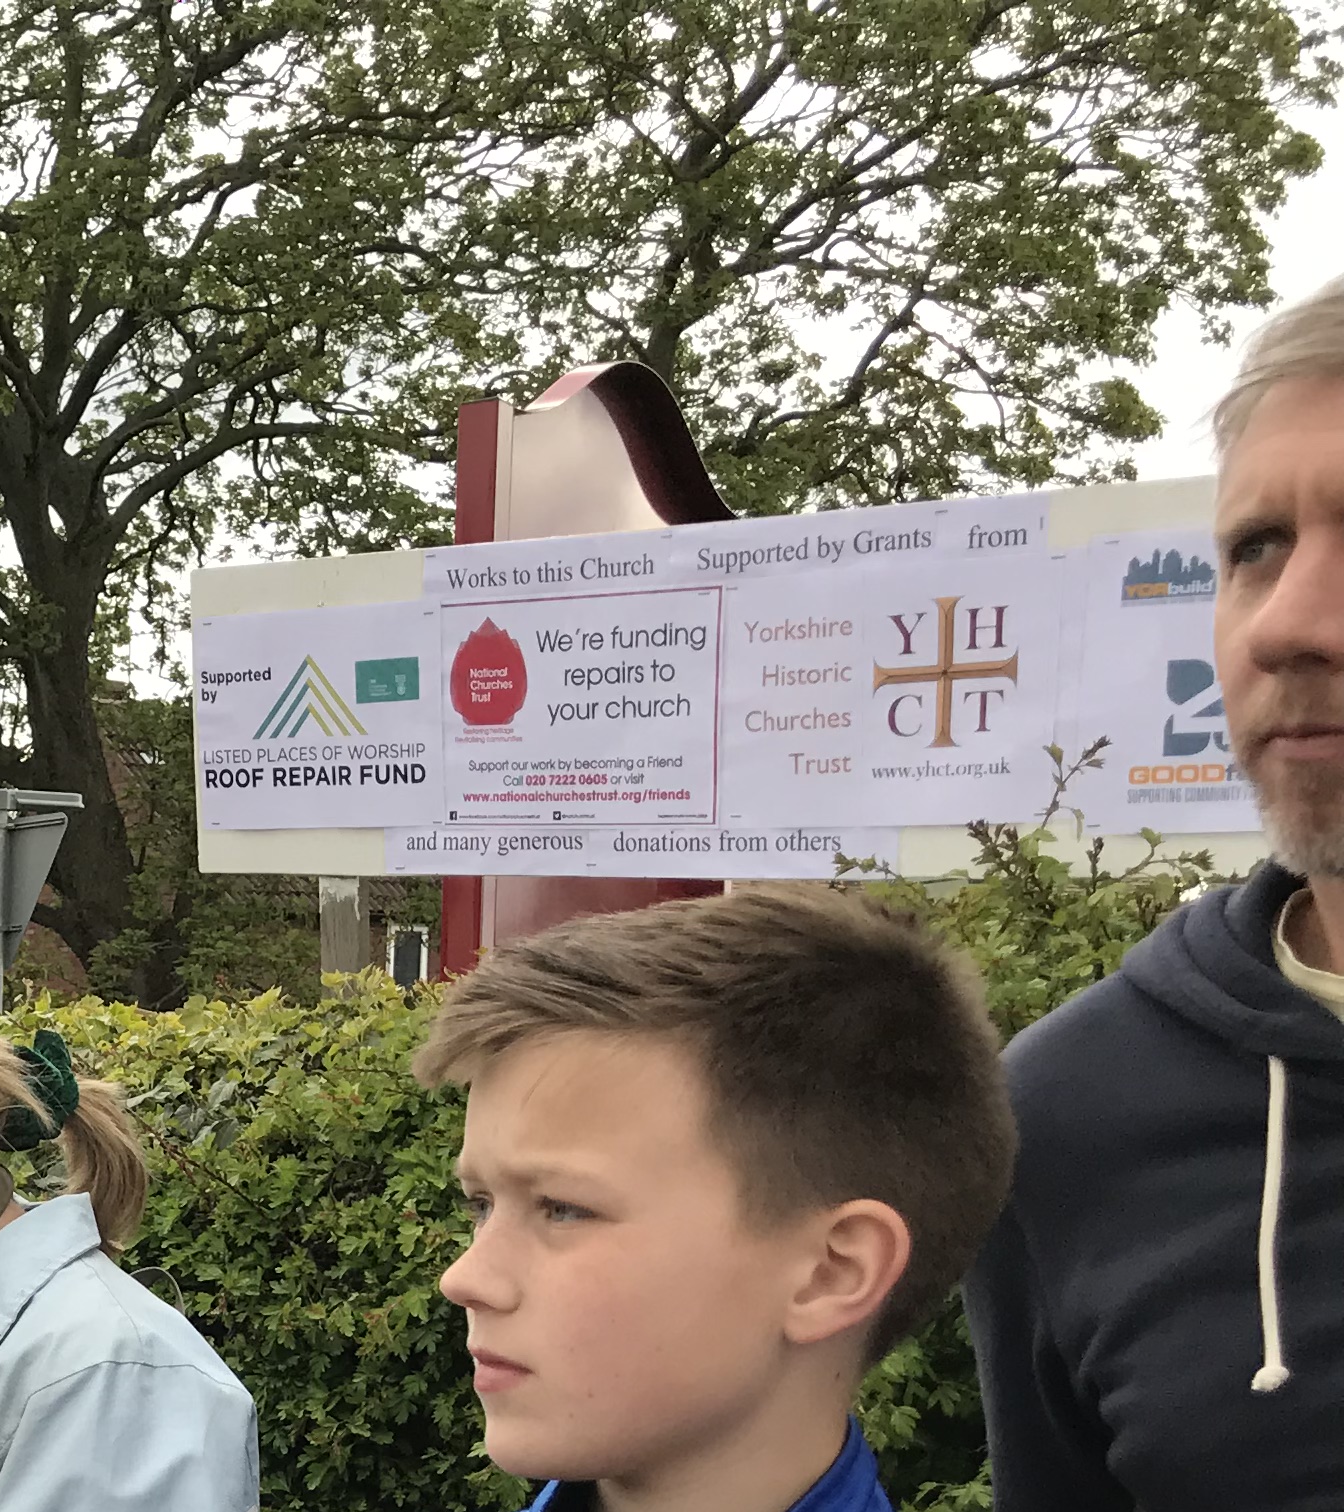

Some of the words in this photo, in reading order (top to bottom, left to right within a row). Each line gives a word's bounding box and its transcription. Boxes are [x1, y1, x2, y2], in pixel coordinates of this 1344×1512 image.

[446, 567, 507, 589] Works
[513, 568, 531, 585] to
[538, 560, 573, 583] this
[580, 553, 654, 580] Church
[697, 537, 809, 573] Supported
[817, 535, 845, 563] by
[853, 529, 932, 554] Grants
[967, 524, 1028, 549] from
[535, 628, 604, 652] We're
[611, 622, 707, 650] funding
[744, 616, 853, 644] Yorkshire
[888, 612, 927, 656] Y
[964, 605, 1010, 650] H
[200, 667, 272, 686] Supported
[470, 667, 508, 678] National
[470, 680, 513, 690] Churches
[564, 661, 645, 690] repairs
[650, 659, 676, 682] to
[762, 662, 853, 687] Historic
[201, 688, 218, 704] by
[471, 692, 491, 702] Trust
[547, 702, 599, 726] your
[605, 693, 691, 719] church
[745, 707, 852, 732] Churches
[888, 694, 923, 738] C
[963, 689, 1004, 733] T
[203, 749, 252, 764] LISTED
[257, 746, 318, 763] PLACES
[322, 745, 343, 760] OF
[348, 743, 426, 760] WORSHIP
[468, 759, 510, 773] Support
[511, 761, 529, 770] our
[530, 758, 556, 770] work
[558, 758, 572, 773] by
[574, 757, 634, 771] becoming
[636, 759, 645, 768] a
[647, 756, 683, 768] Friend
[788, 752, 852, 775] Trust
[205, 767, 264, 788] ROOF
[272, 765, 352, 787] REPAIR
[360, 763, 426, 785] FUND
[502, 775, 523, 786] Call
[525, 775, 546, 786] 020
[548, 774, 576, 786] 7222
[578, 773, 608, 785] 0605
[610, 775, 622, 784] or
[623, 773, 645, 784] visit
[871, 757, 1011, 782] www.yhct.org.uk
[463, 788, 691, 803] www.nationalchurchestrust.org/friends
[406, 833, 438, 852] and
[442, 835, 491, 856] many
[497, 833, 583, 856] generous
[613, 831, 711, 853] donations
[718, 830, 768, 852] from
[774, 830, 842, 853] others
